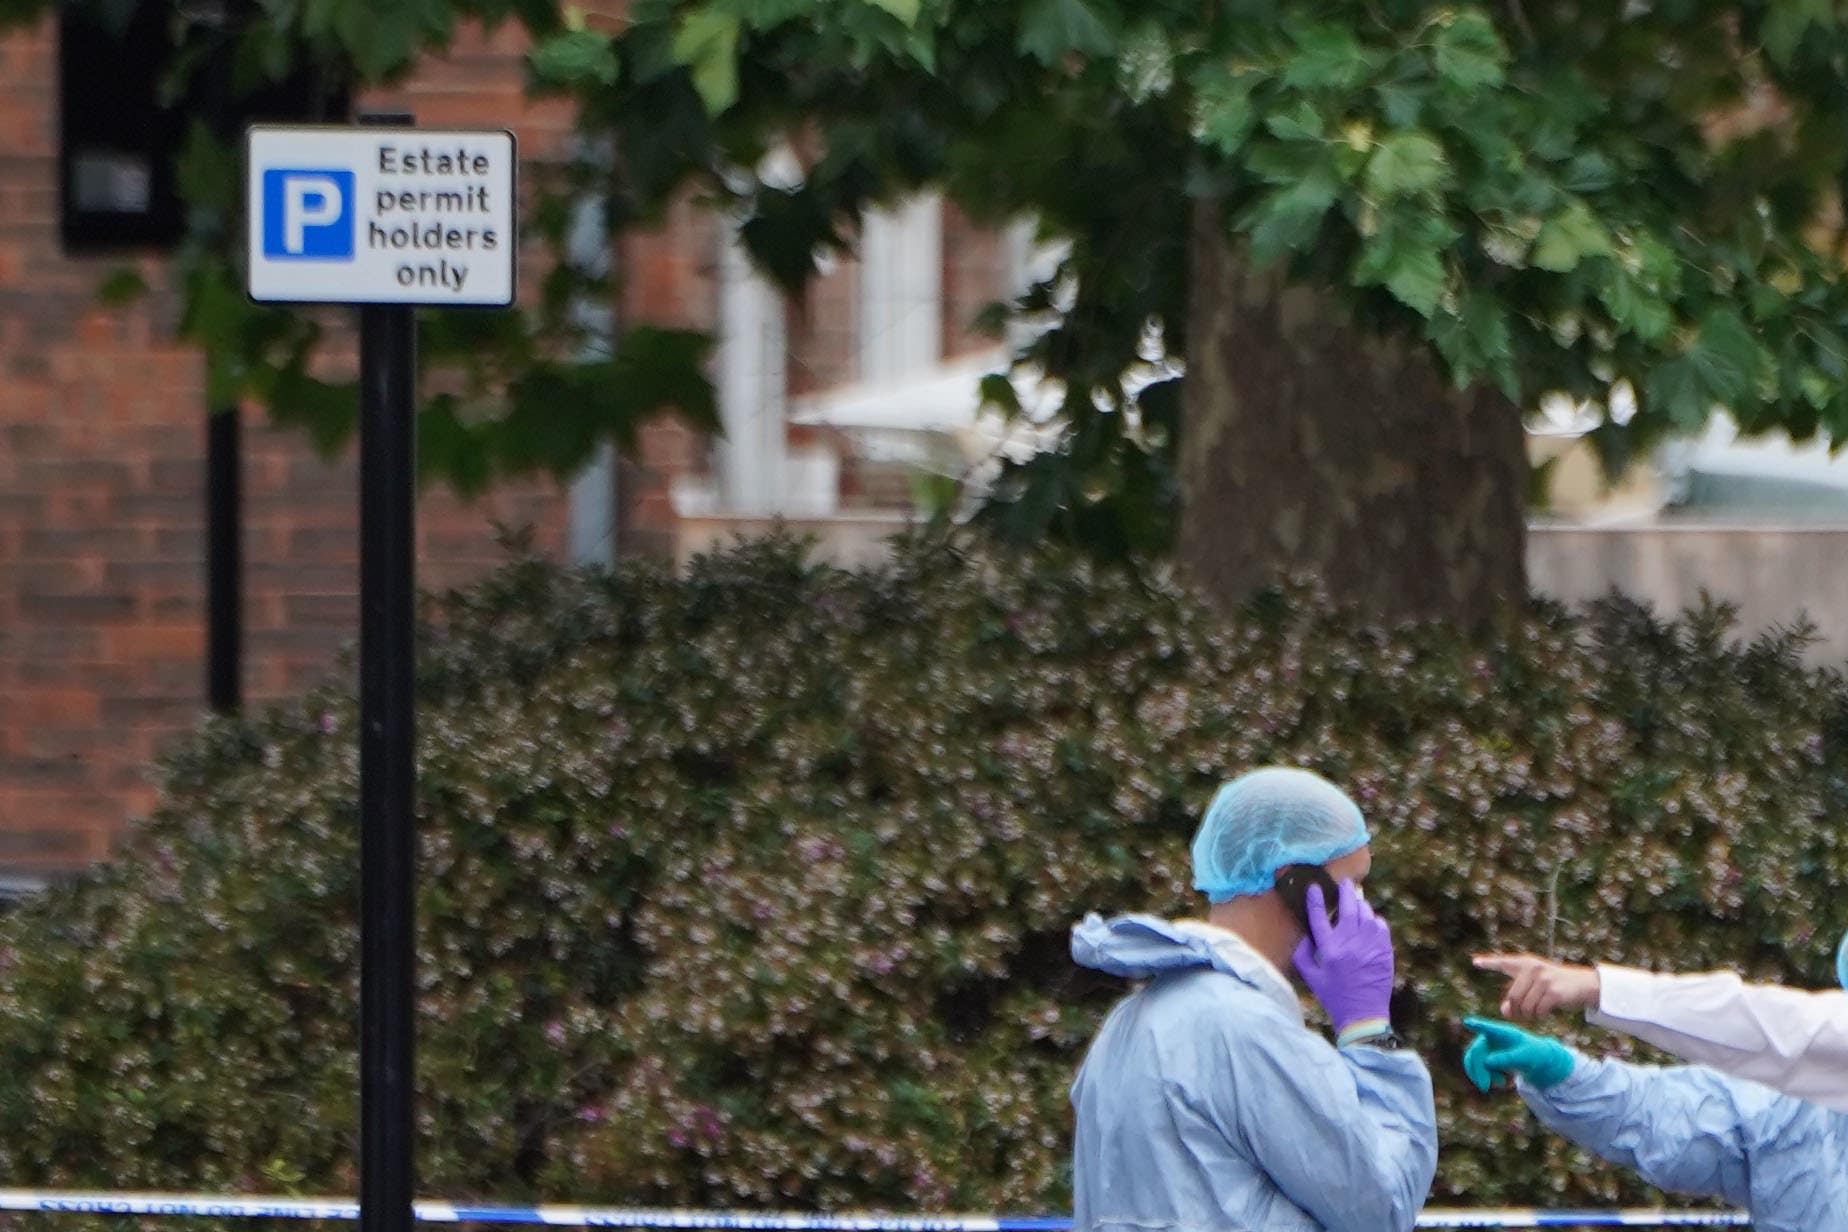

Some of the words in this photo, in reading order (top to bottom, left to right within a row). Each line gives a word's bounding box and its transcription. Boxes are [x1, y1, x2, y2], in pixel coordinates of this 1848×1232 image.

[379, 147, 489, 176] Estate
[376, 186, 490, 215] permit
[284, 177, 342, 254] P
[368, 221, 499, 249] holders
[397, 260, 468, 292] only
